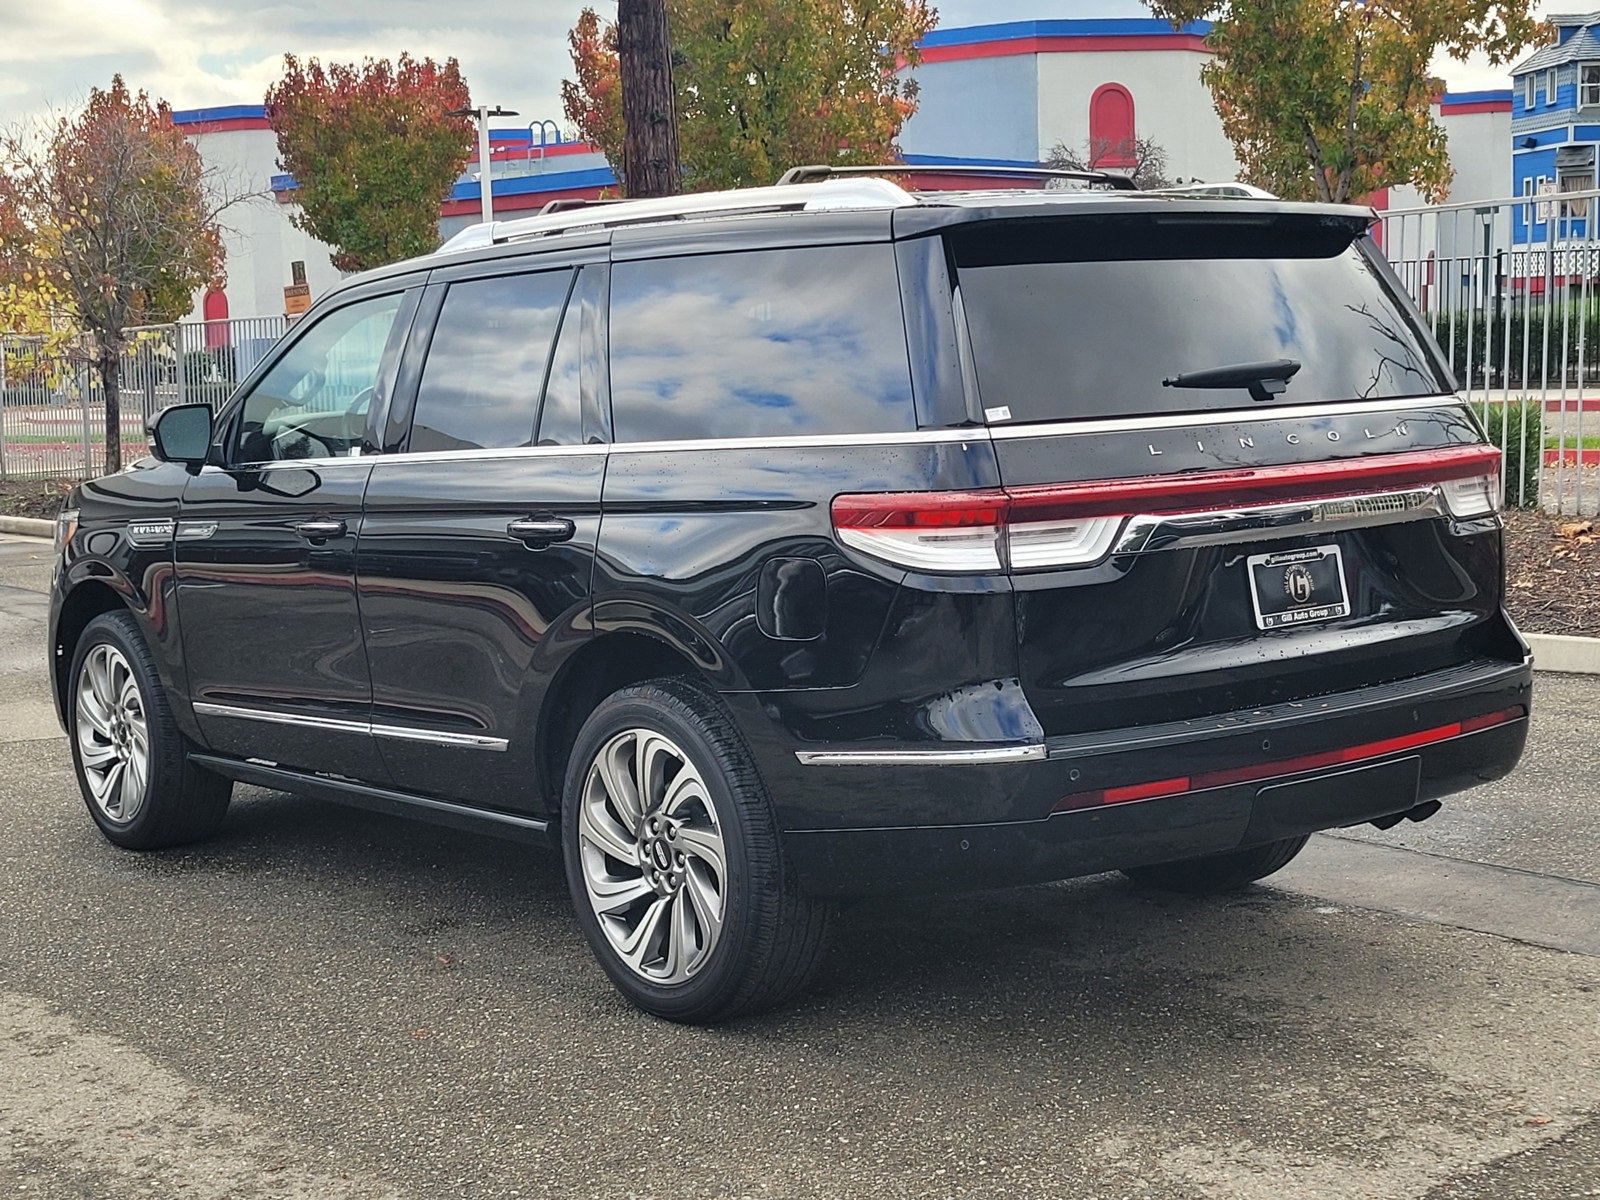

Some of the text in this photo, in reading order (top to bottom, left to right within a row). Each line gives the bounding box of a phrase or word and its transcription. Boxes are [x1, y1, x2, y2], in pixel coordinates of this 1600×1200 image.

[1148, 426, 1408, 456] LINCOLN
[1281, 608, 1329, 622] Gill Auto Group
